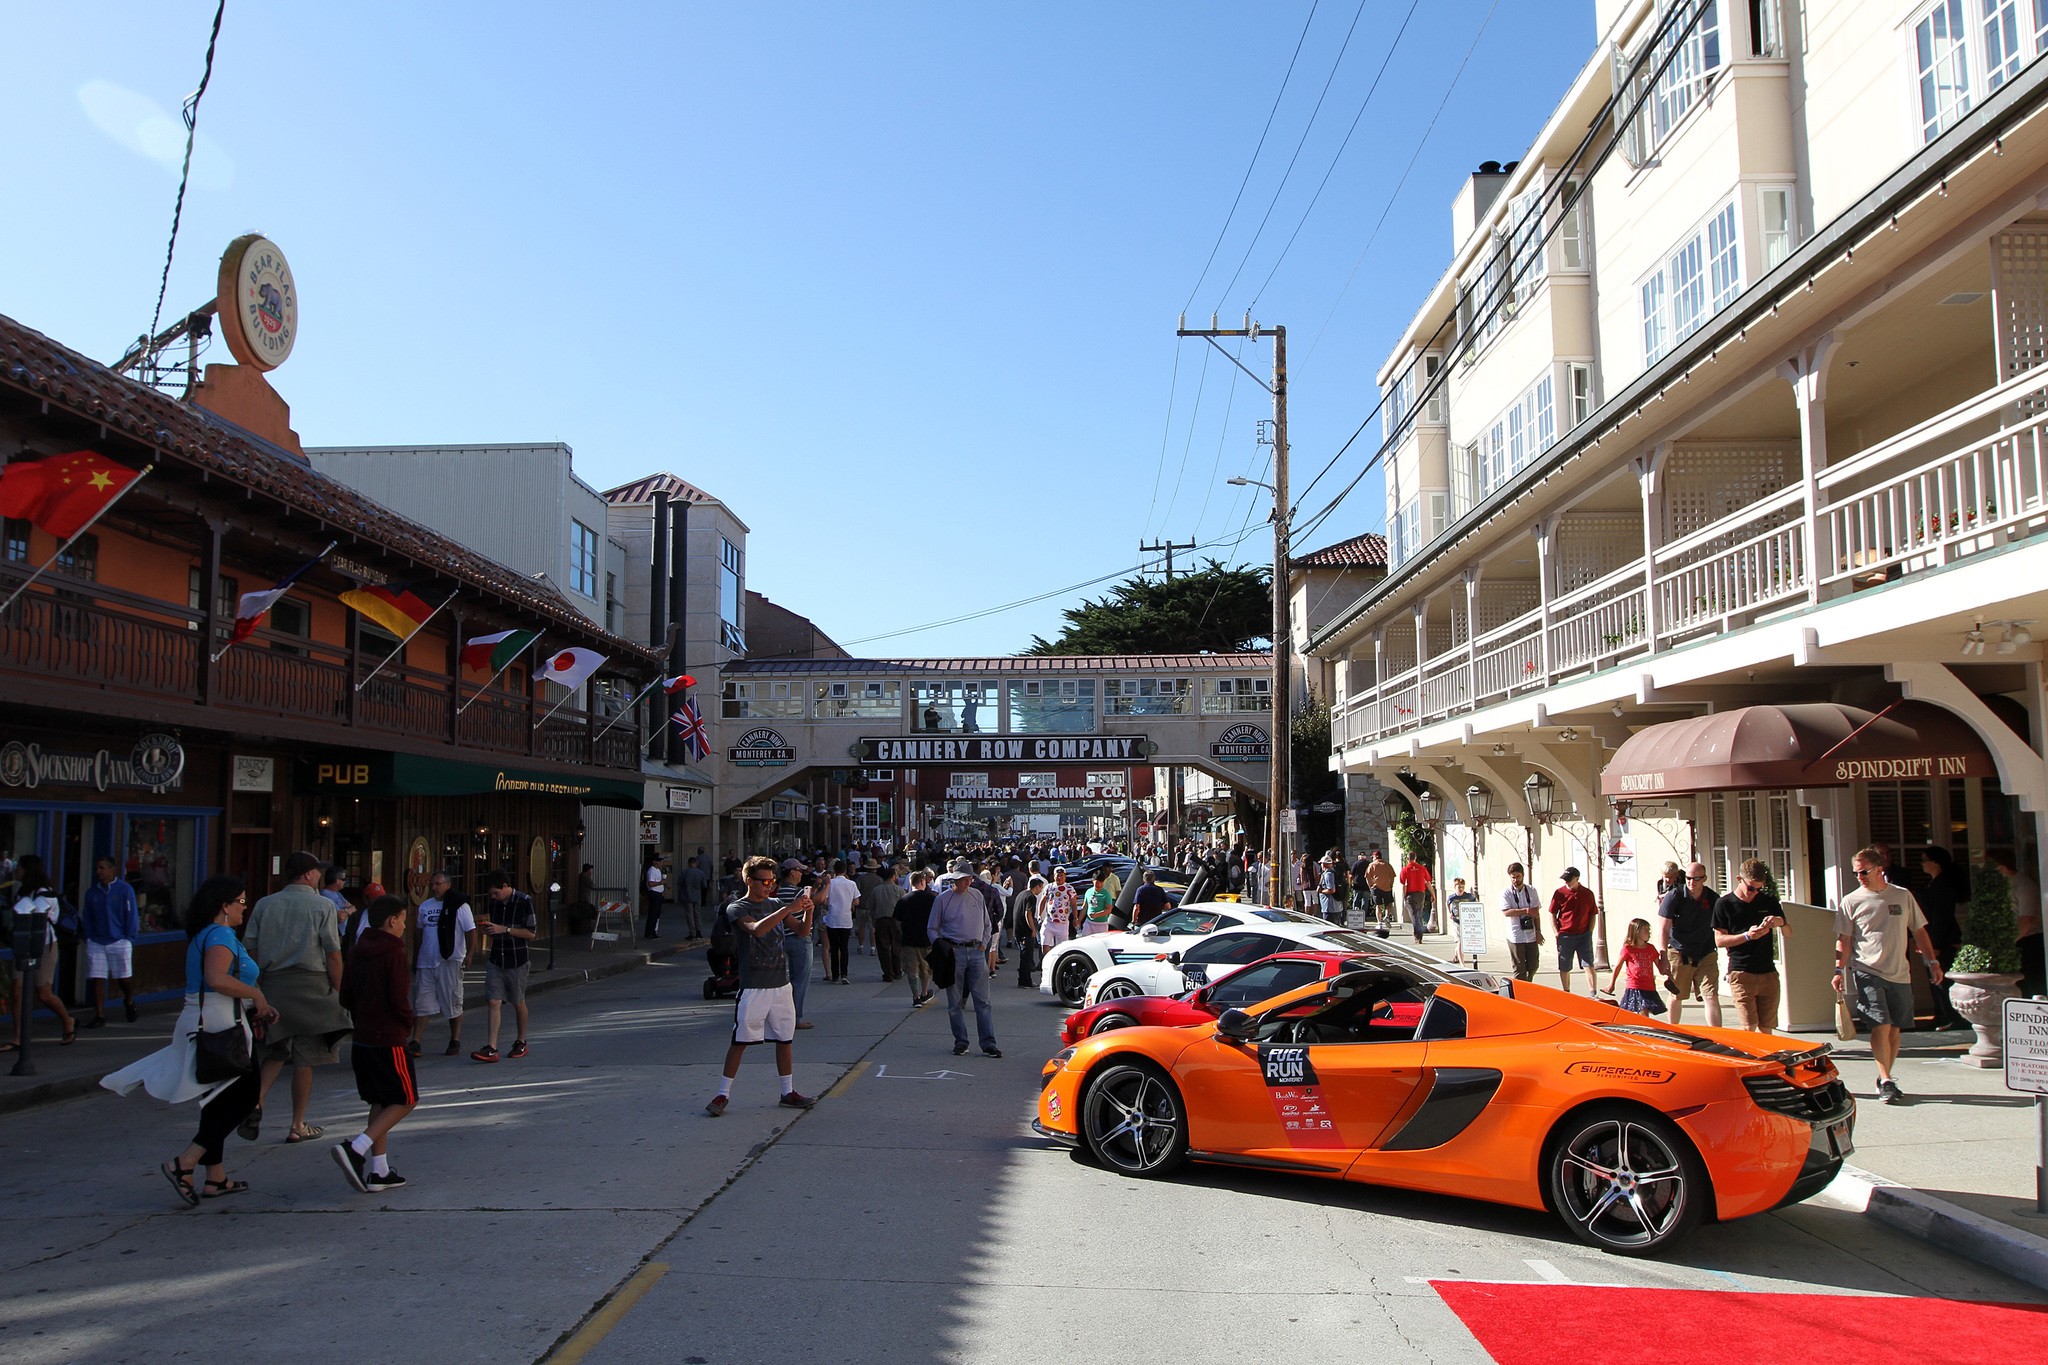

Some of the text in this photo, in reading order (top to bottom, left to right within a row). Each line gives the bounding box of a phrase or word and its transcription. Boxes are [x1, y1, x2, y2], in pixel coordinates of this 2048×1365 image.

[250, 254, 292, 307] BEAR FLAG
[249, 304, 290, 350] BUILDING
[741, 730, 784, 747] CANNERY ROW
[1224, 725, 1266, 742] CANNERY ROW
[135, 735, 180, 754] SOCKSHOP
[877, 739, 1134, 760] CANNERY ROW COMPANY
[237, 757, 269, 773] KNRY
[1835, 756, 1967, 780] SPINDRIFT INN
[317, 764, 370, 785] PUB
[945, 786, 1126, 799] MONTEREY CANNING CO.
[1186, 971, 1204, 982] FUEL
[2009, 1037, 2034, 1046] GUEST
[1268, 1048, 1304, 1062] FUEL
[2029, 1046, 2048, 1056] ZONE
[1266, 1062, 1304, 1078] RUN
[1580, 1065, 1662, 1079] SUPERCARS
[1596, 1073, 1639, 1081] PERSONIFIED
